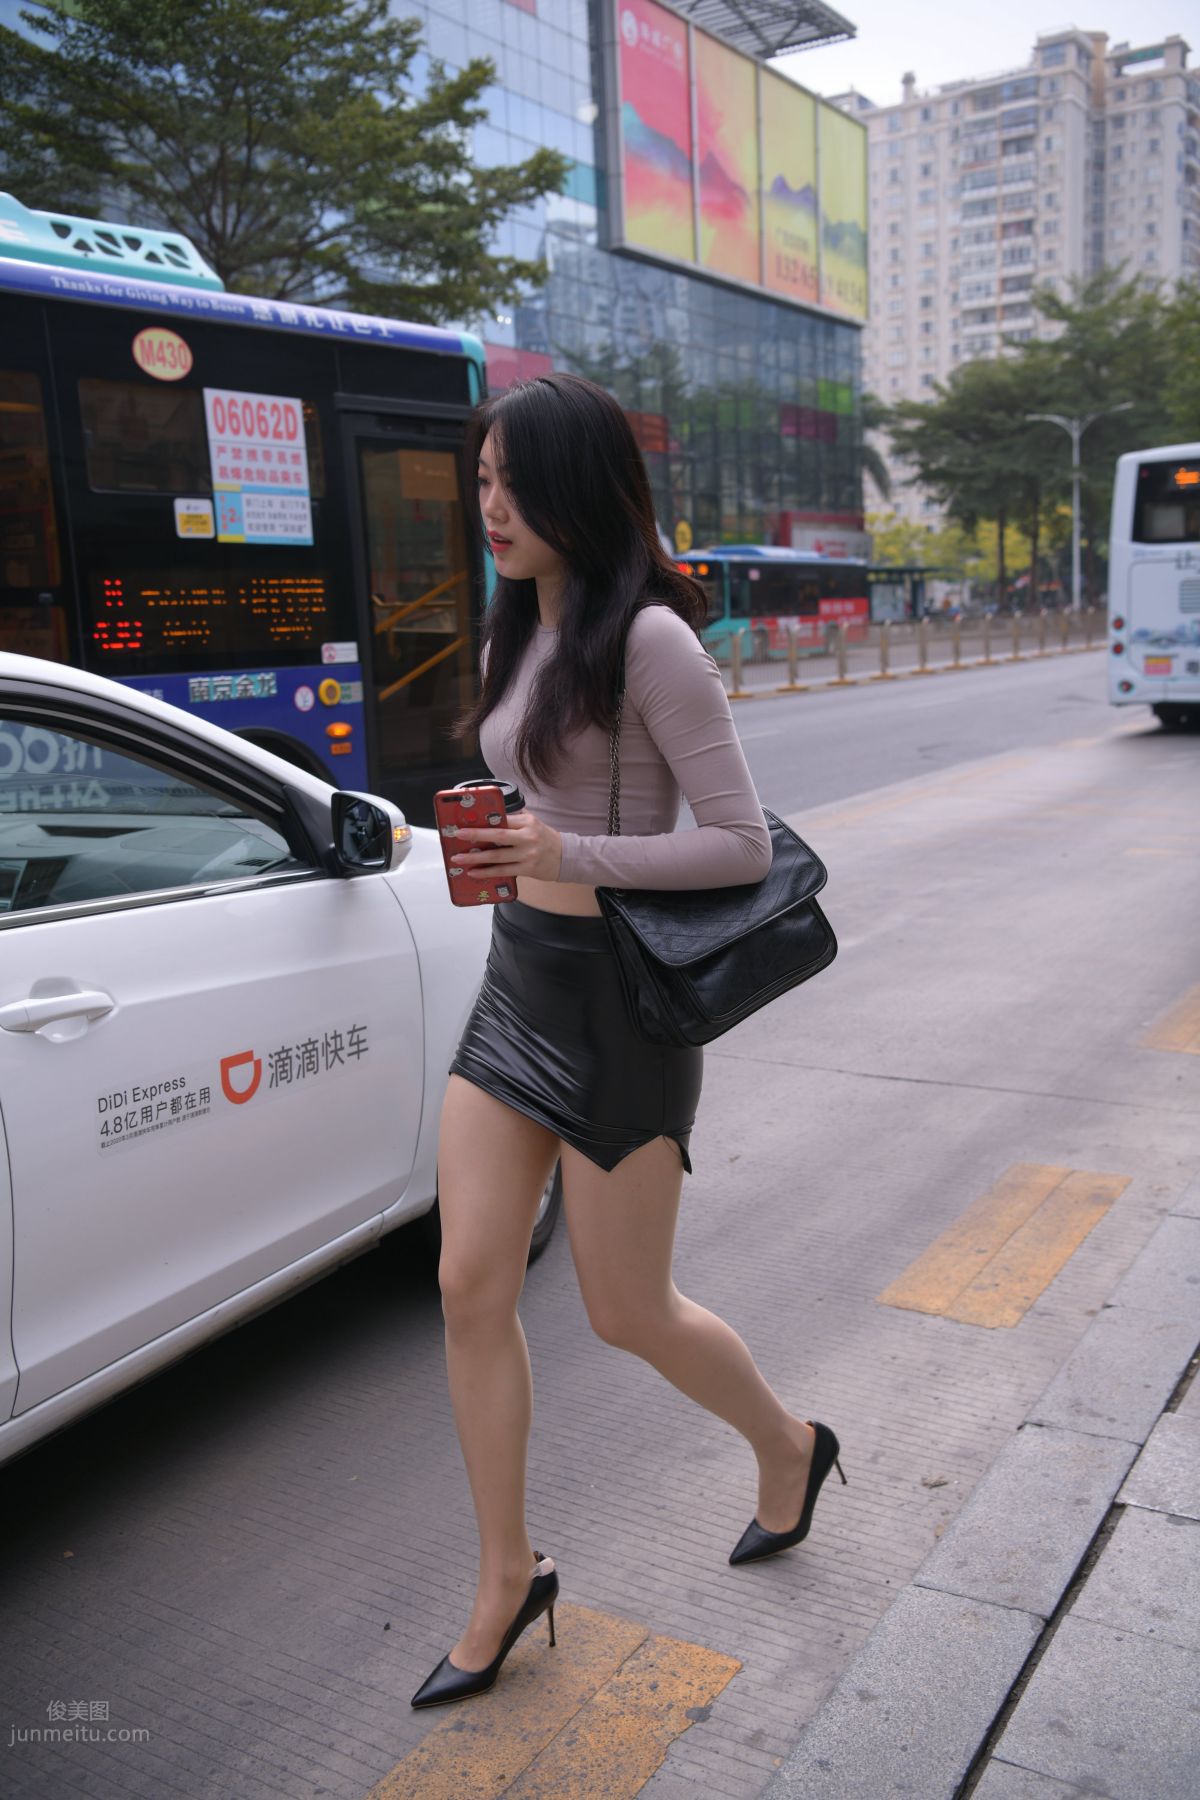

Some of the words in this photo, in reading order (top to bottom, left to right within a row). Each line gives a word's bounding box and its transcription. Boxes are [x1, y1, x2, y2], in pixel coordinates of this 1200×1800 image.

[50, 275, 102, 295] Thanks
[103, 283, 123, 297] for
[126, 287, 168, 305] Giving
[168, 293, 194, 309] Way
[197, 296, 210, 309] to
[138, 336, 190, 372] M430
[212, 395, 299, 441] 06062D
[188, 671, 278, 704] 南京金龙
[267, 1023, 370, 1090] 滴滴快车
[97, 1090, 129, 1114] DiDi
[132, 1076, 187, 1102] Express
[99, 1086, 212, 1137] 4.8亿用户都在用
